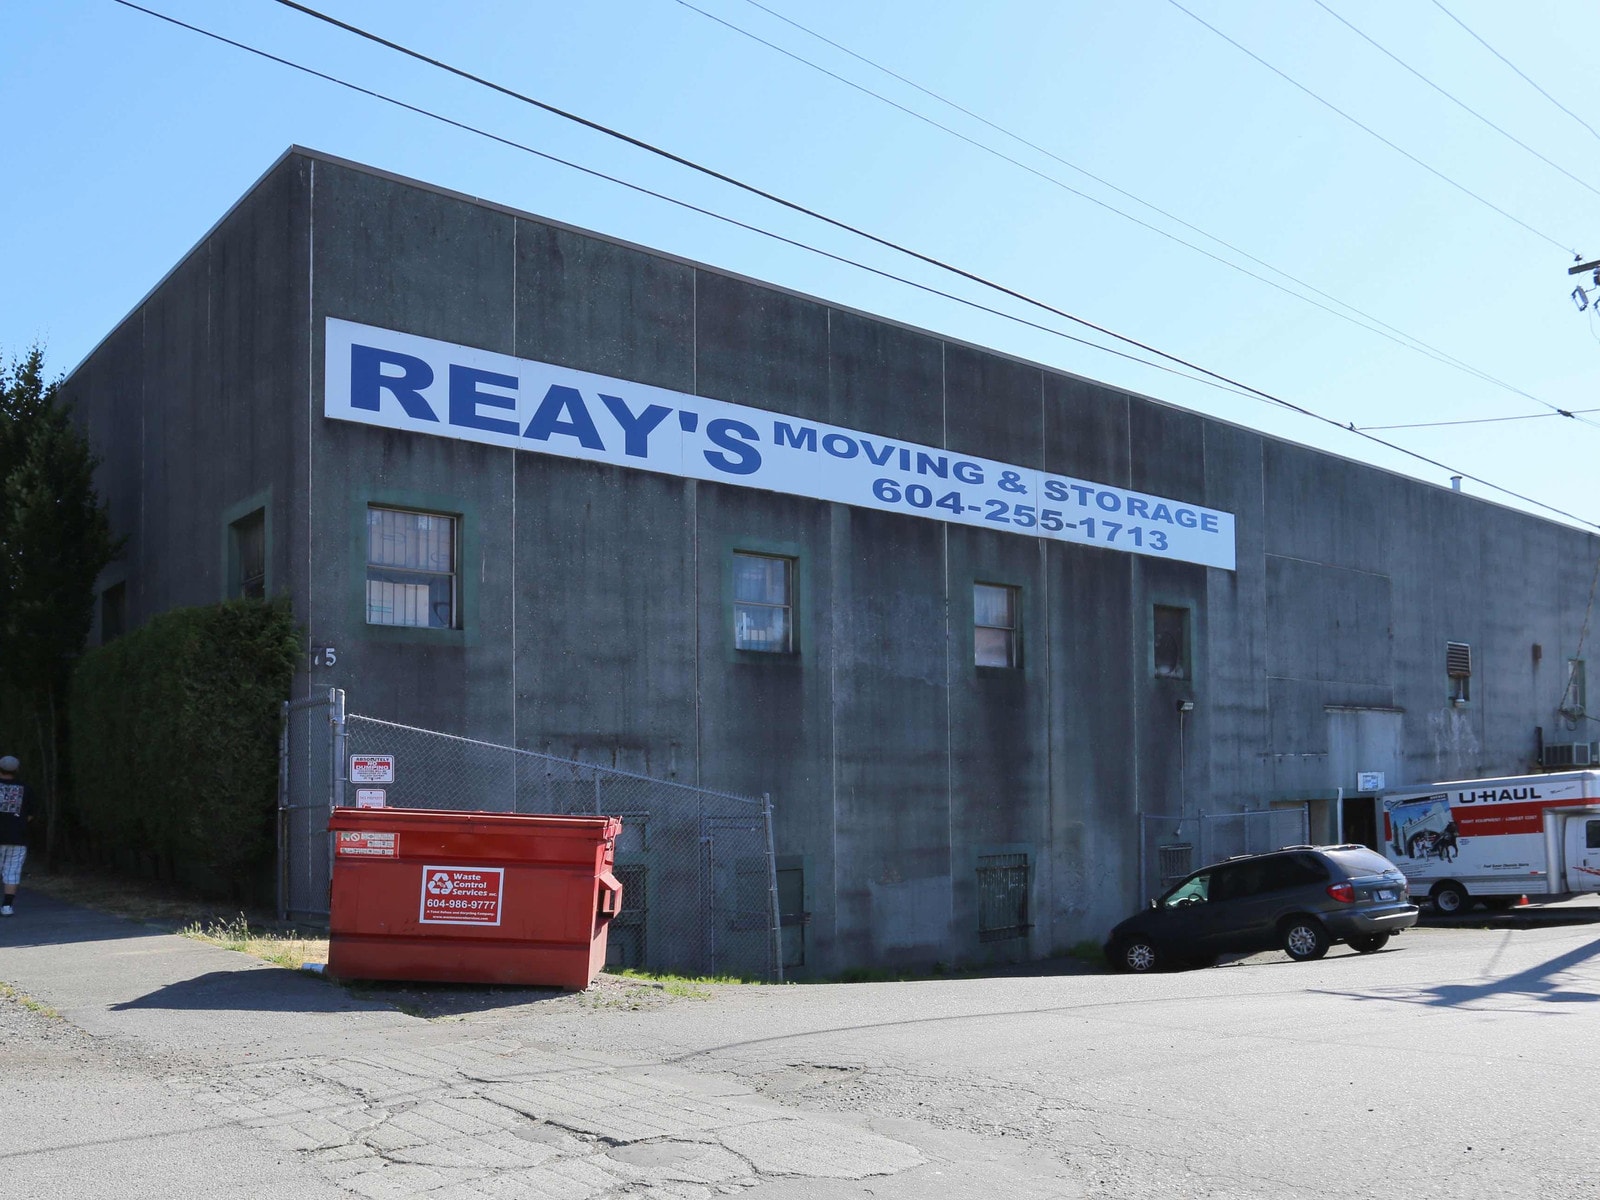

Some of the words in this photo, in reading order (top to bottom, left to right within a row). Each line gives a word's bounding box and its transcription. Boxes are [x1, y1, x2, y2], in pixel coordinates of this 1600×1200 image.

[351, 343, 762, 475] REAY'S
[773, 421, 985, 485] MOVING
[997, 470, 1028, 495] &
[1044, 480, 1219, 533] STORAGE
[872, 478, 1169, 551] 604-255-1713
[1459, 788, 1542, 804] U-HAUL
[453, 873, 481, 881] Waste
[452, 888, 488, 896] Services
[453, 881, 487, 889] Control
[427, 898, 496, 910] 604-986-9777
